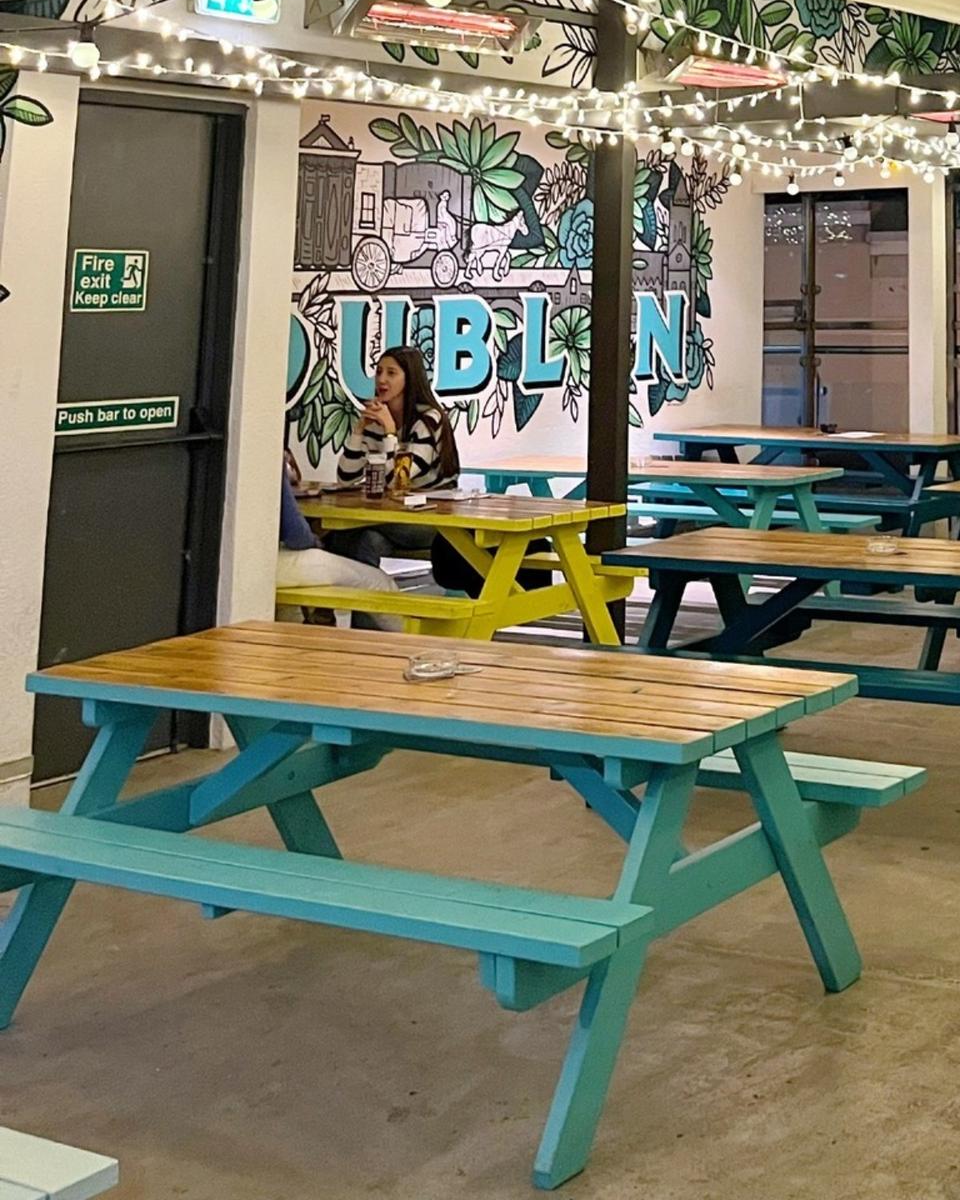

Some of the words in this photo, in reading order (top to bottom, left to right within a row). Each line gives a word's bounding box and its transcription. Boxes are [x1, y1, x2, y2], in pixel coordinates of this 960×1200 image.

[82, 255, 115, 271] Fire
[80, 273, 111, 289] exit
[75, 291, 108, 307] Keep
[111, 291, 142, 304] clear
[286, 292, 690, 409] UBLN
[58, 409, 94, 424] Push
[97, 409, 120, 421] bar
[123, 407, 136, 420] to
[140, 406, 172, 421] open
